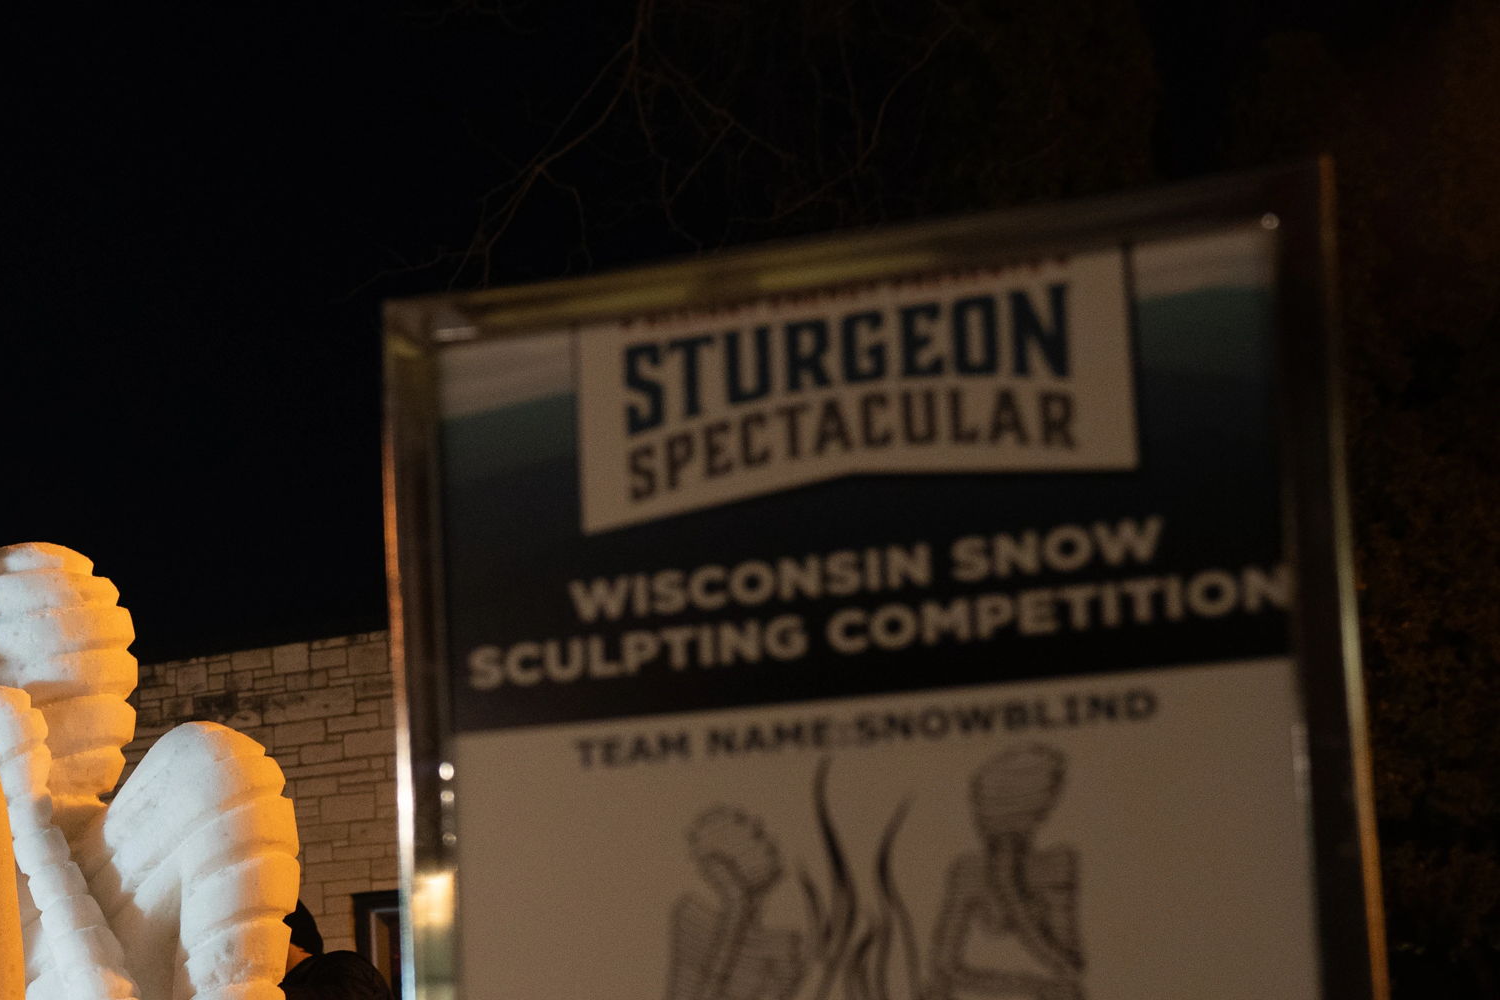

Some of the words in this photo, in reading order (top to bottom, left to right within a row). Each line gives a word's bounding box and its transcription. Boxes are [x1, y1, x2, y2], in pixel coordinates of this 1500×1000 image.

[626, 282, 1072, 437] STURGEON
[629, 390, 1079, 504] SPECTACULAR
[469, 614, 809, 692] SCULPTING
[827, 563, 1295, 656] COMPETITION
[570, 543, 934, 624] WISCONSIN
[952, 517, 1164, 584] SNOW
[574, 732, 690, 769] TEAM
